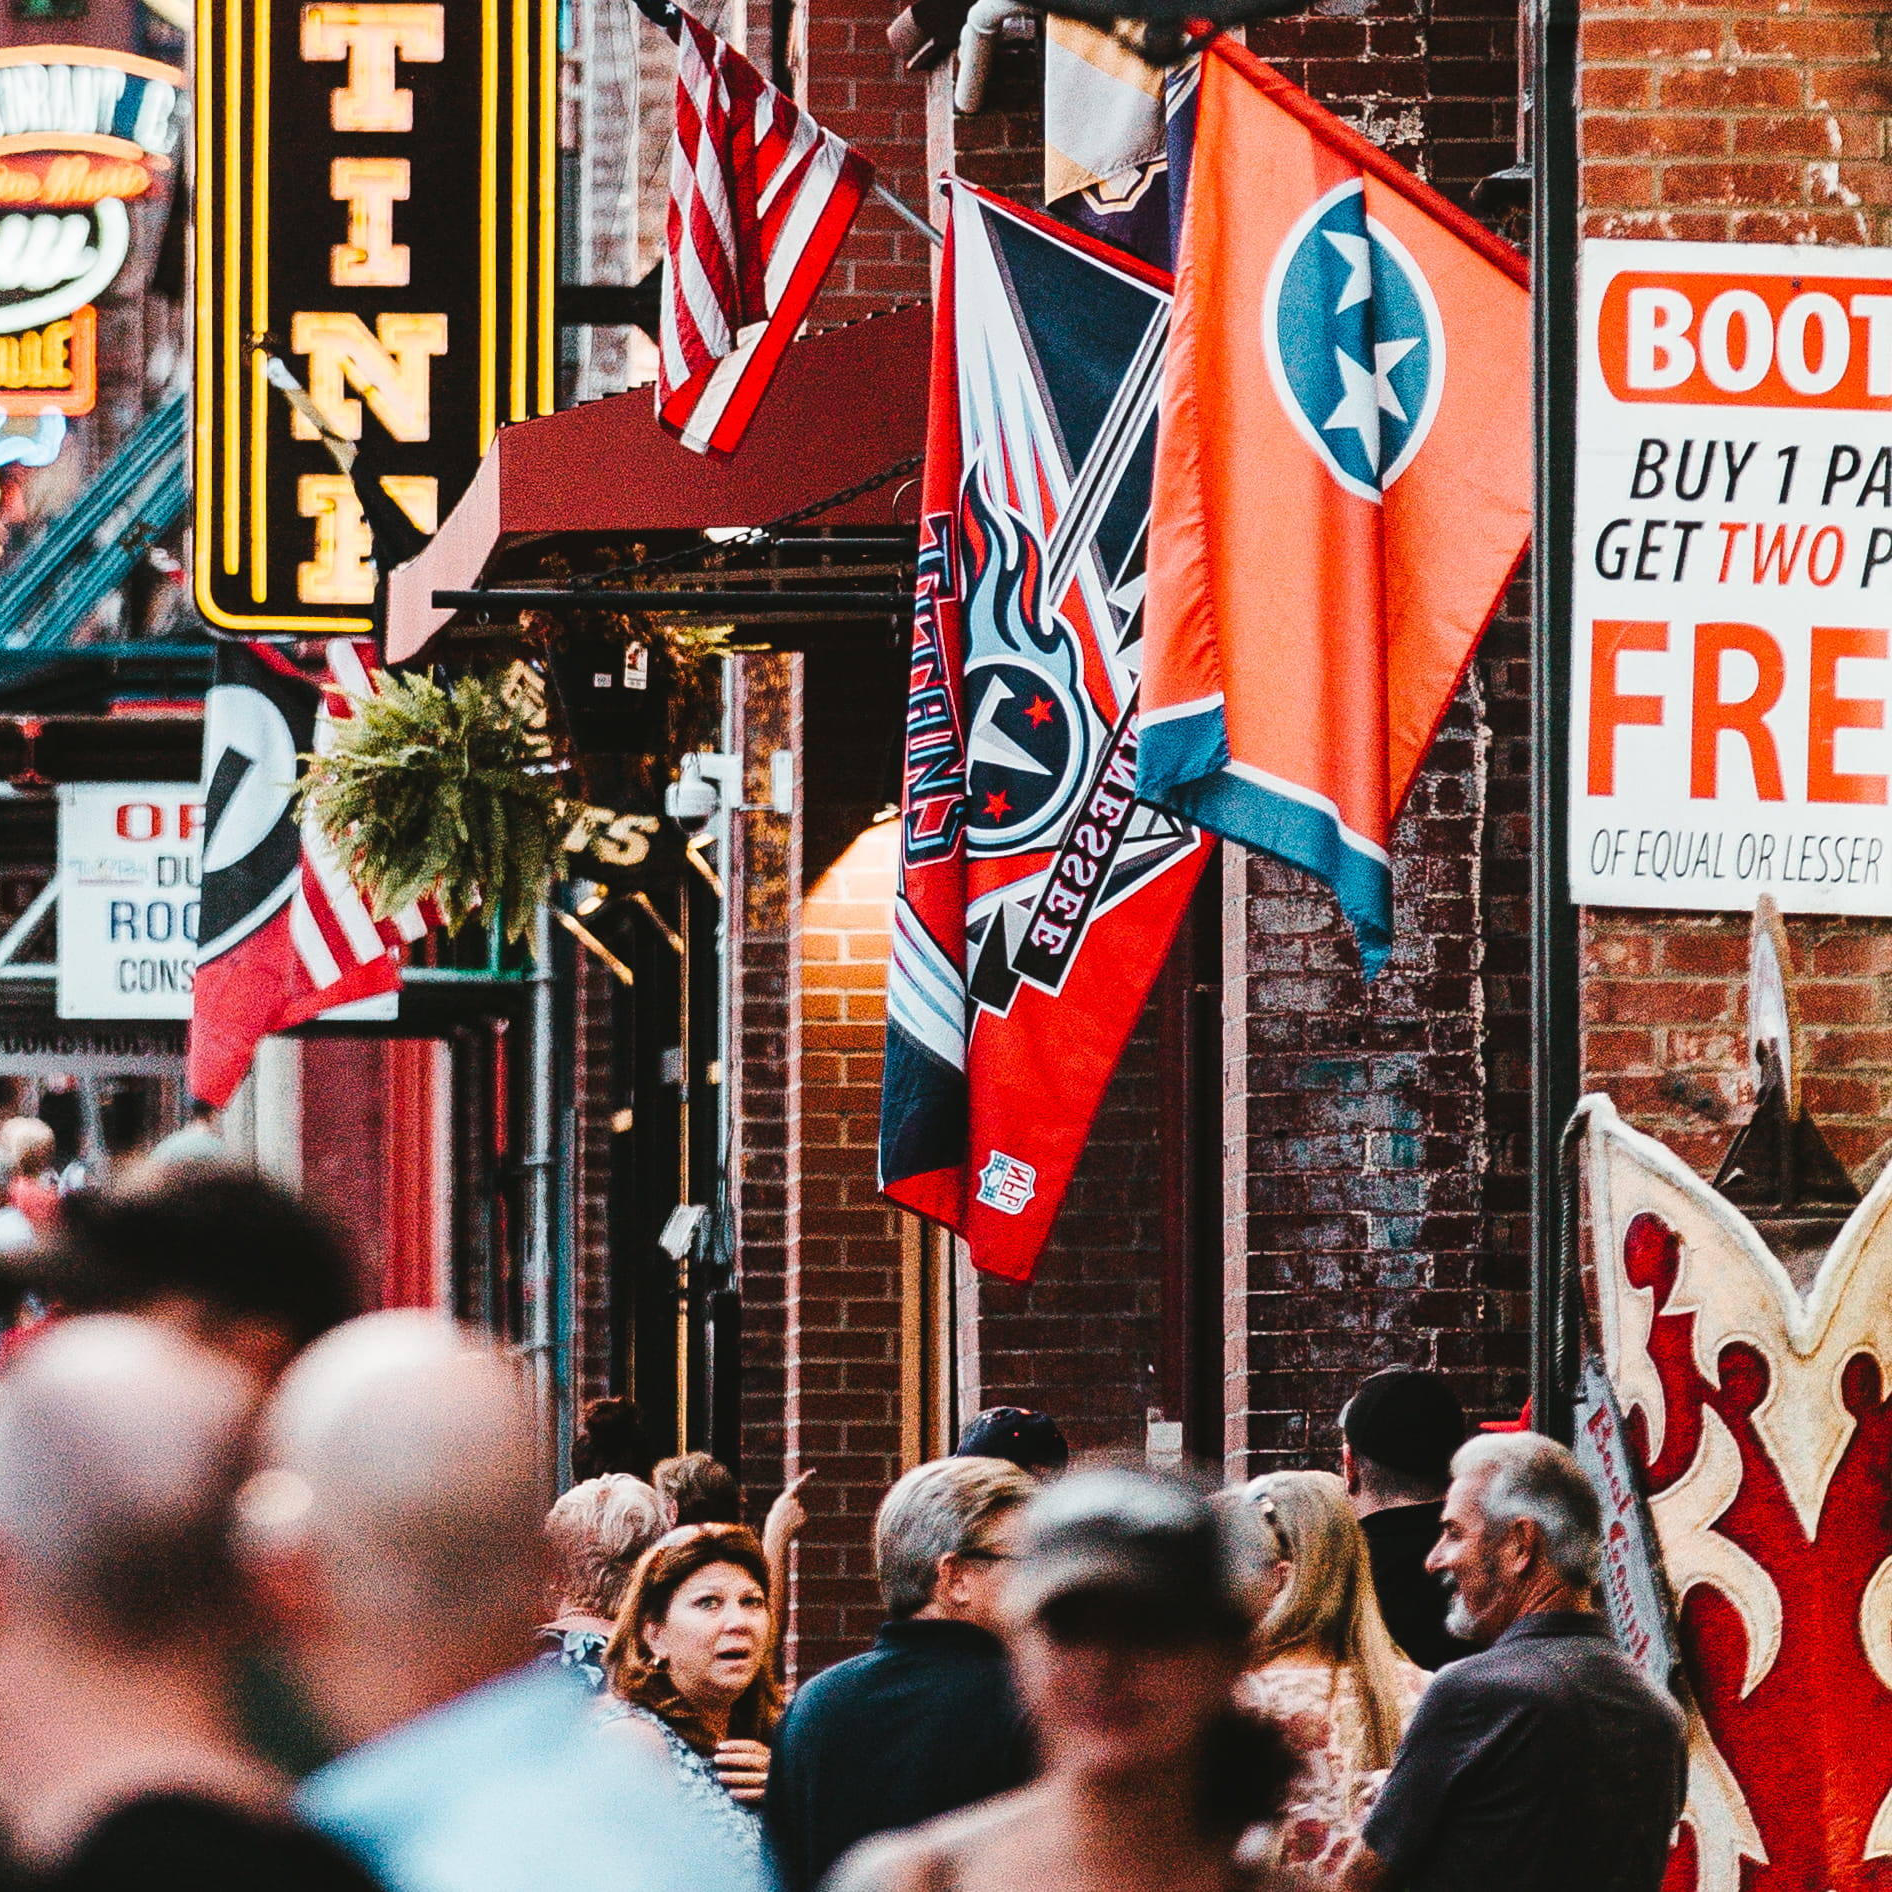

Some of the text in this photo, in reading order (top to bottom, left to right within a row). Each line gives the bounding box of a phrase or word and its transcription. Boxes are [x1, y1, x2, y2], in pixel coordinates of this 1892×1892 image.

[1626, 283, 1892, 397] BOOT
[1630, 439, 1761, 504] BUY
[1776, 445, 1800, 507] 1
[1595, 519, 1704, 583] GET
[1717, 522, 1846, 588] TWO
[1591, 829, 1882, 885] OF EQUAL OR LESSER
